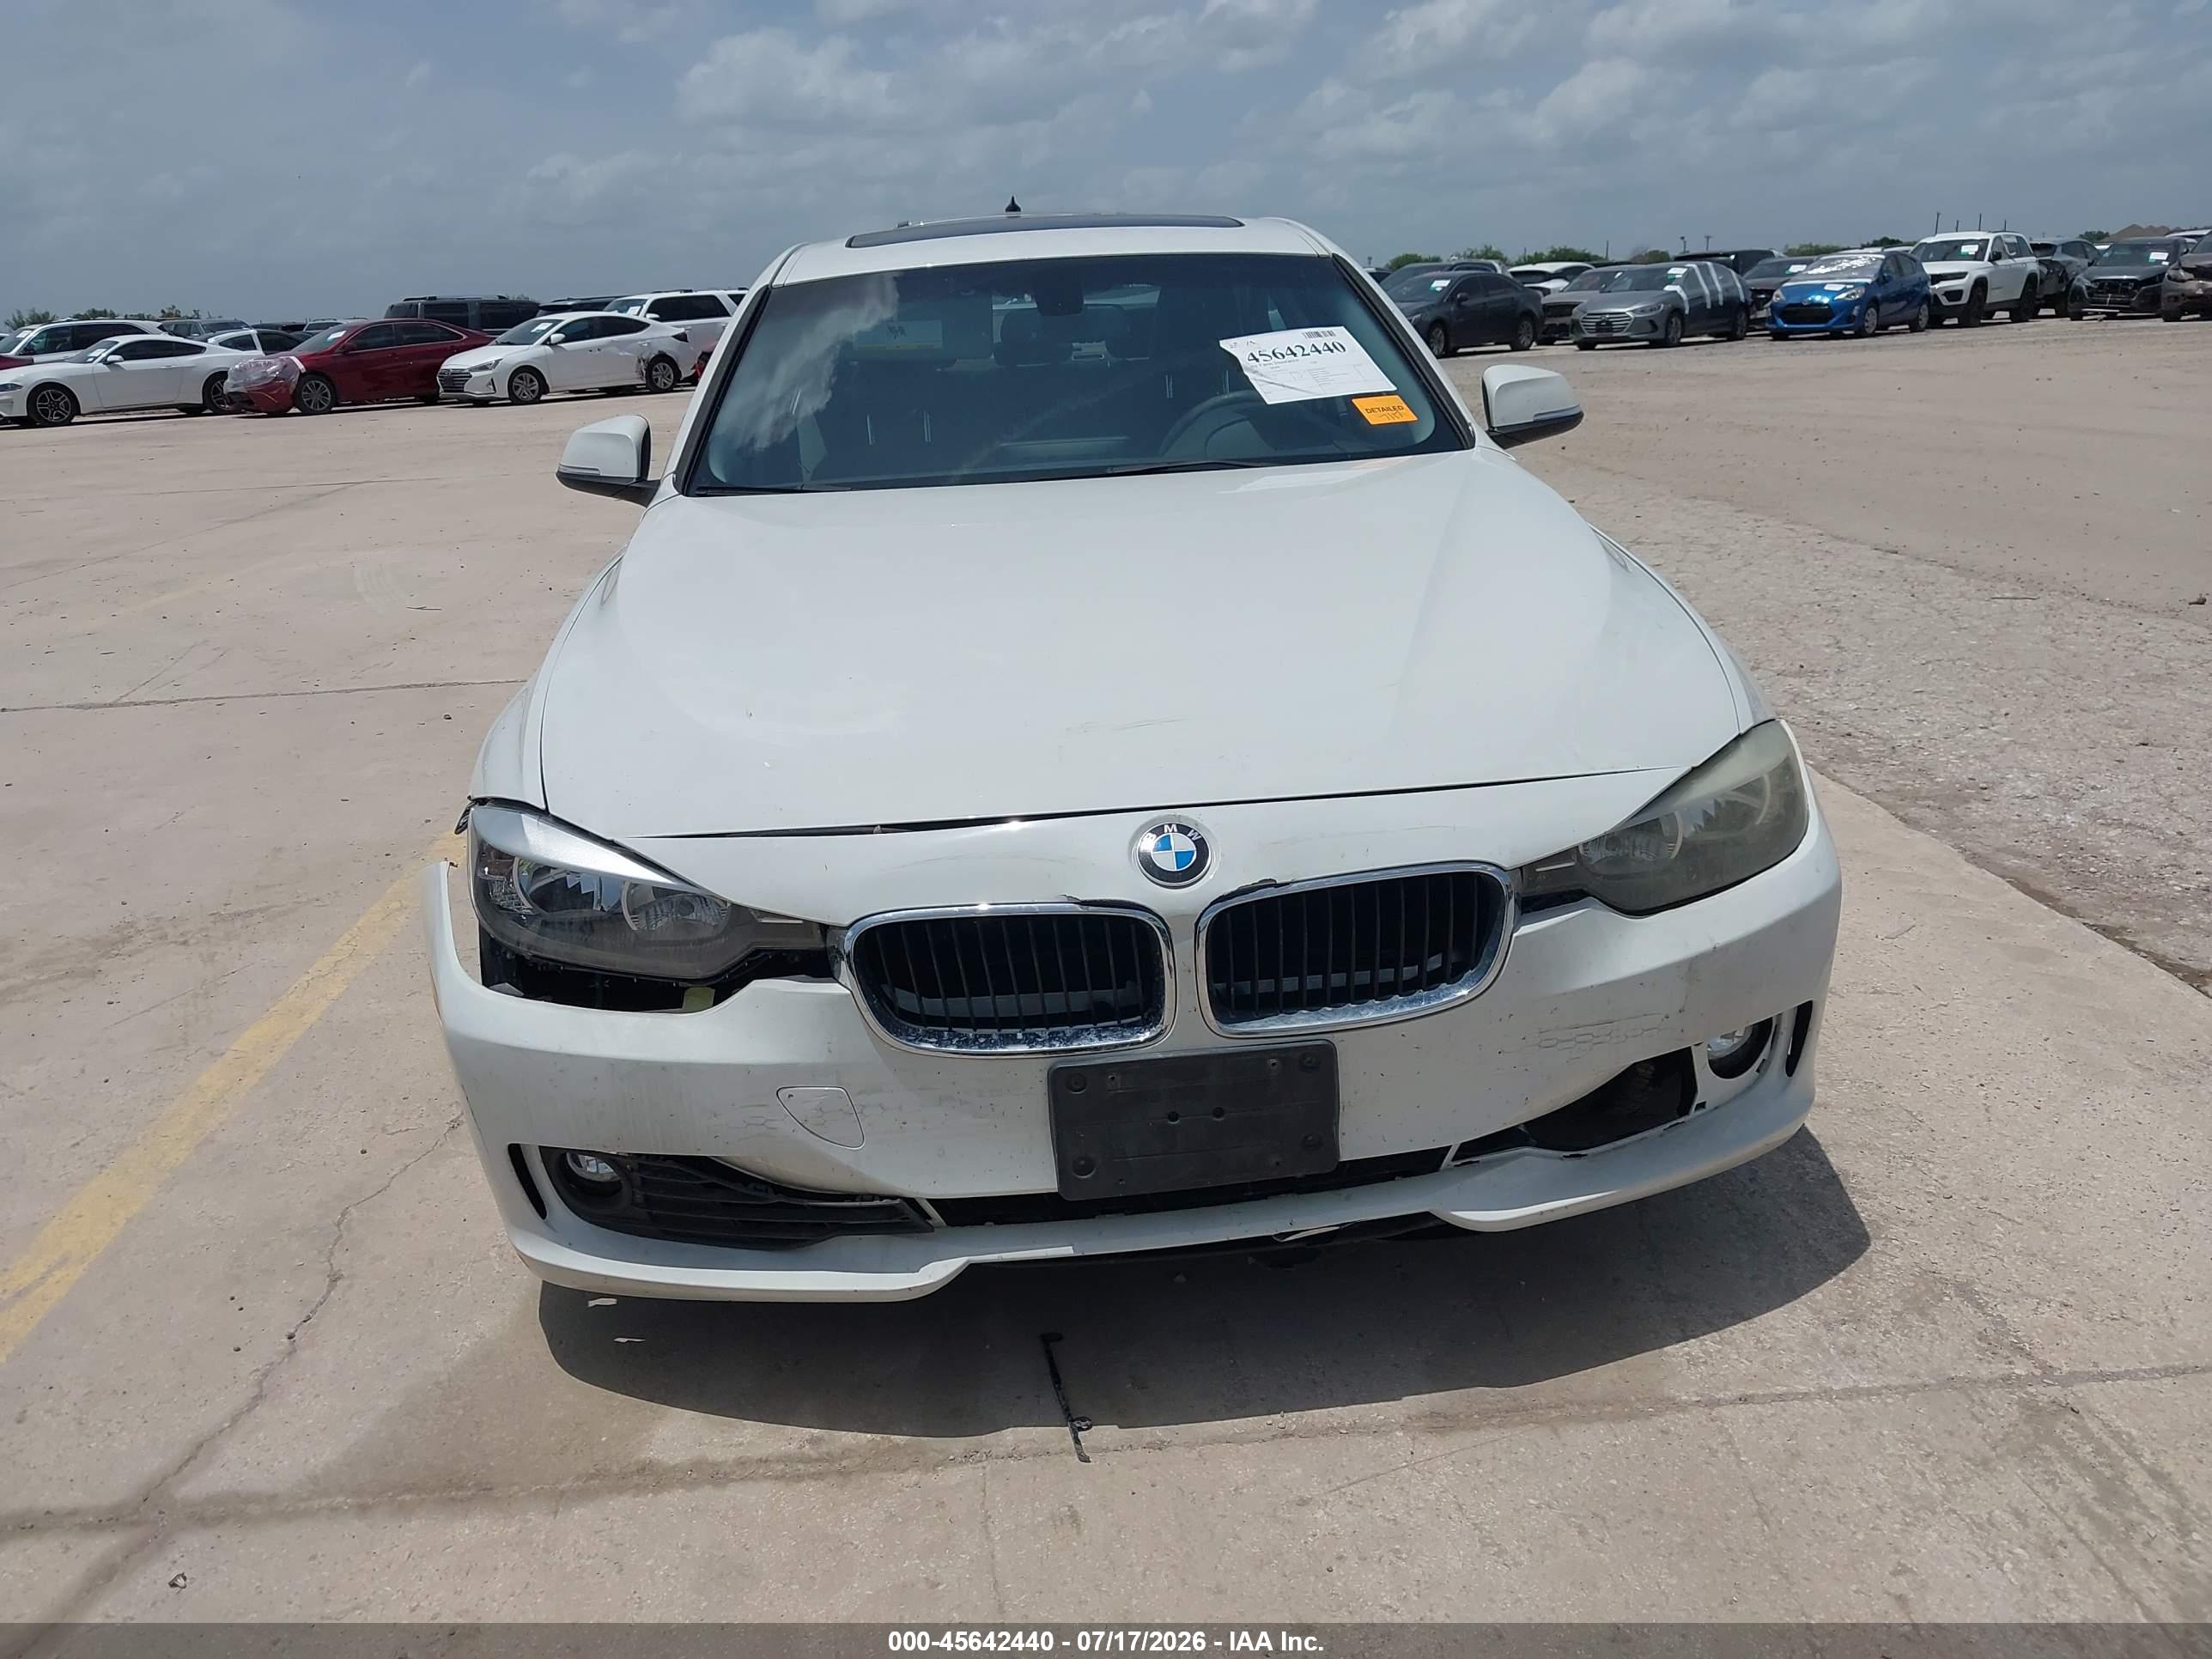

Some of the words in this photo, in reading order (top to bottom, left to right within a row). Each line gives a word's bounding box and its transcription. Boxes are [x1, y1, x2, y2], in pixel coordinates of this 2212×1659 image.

[1247, 341, 1346, 363] 45642440
[1365, 405, 1405, 414] DETAILED
[1140, 823, 1202, 848] BMW
